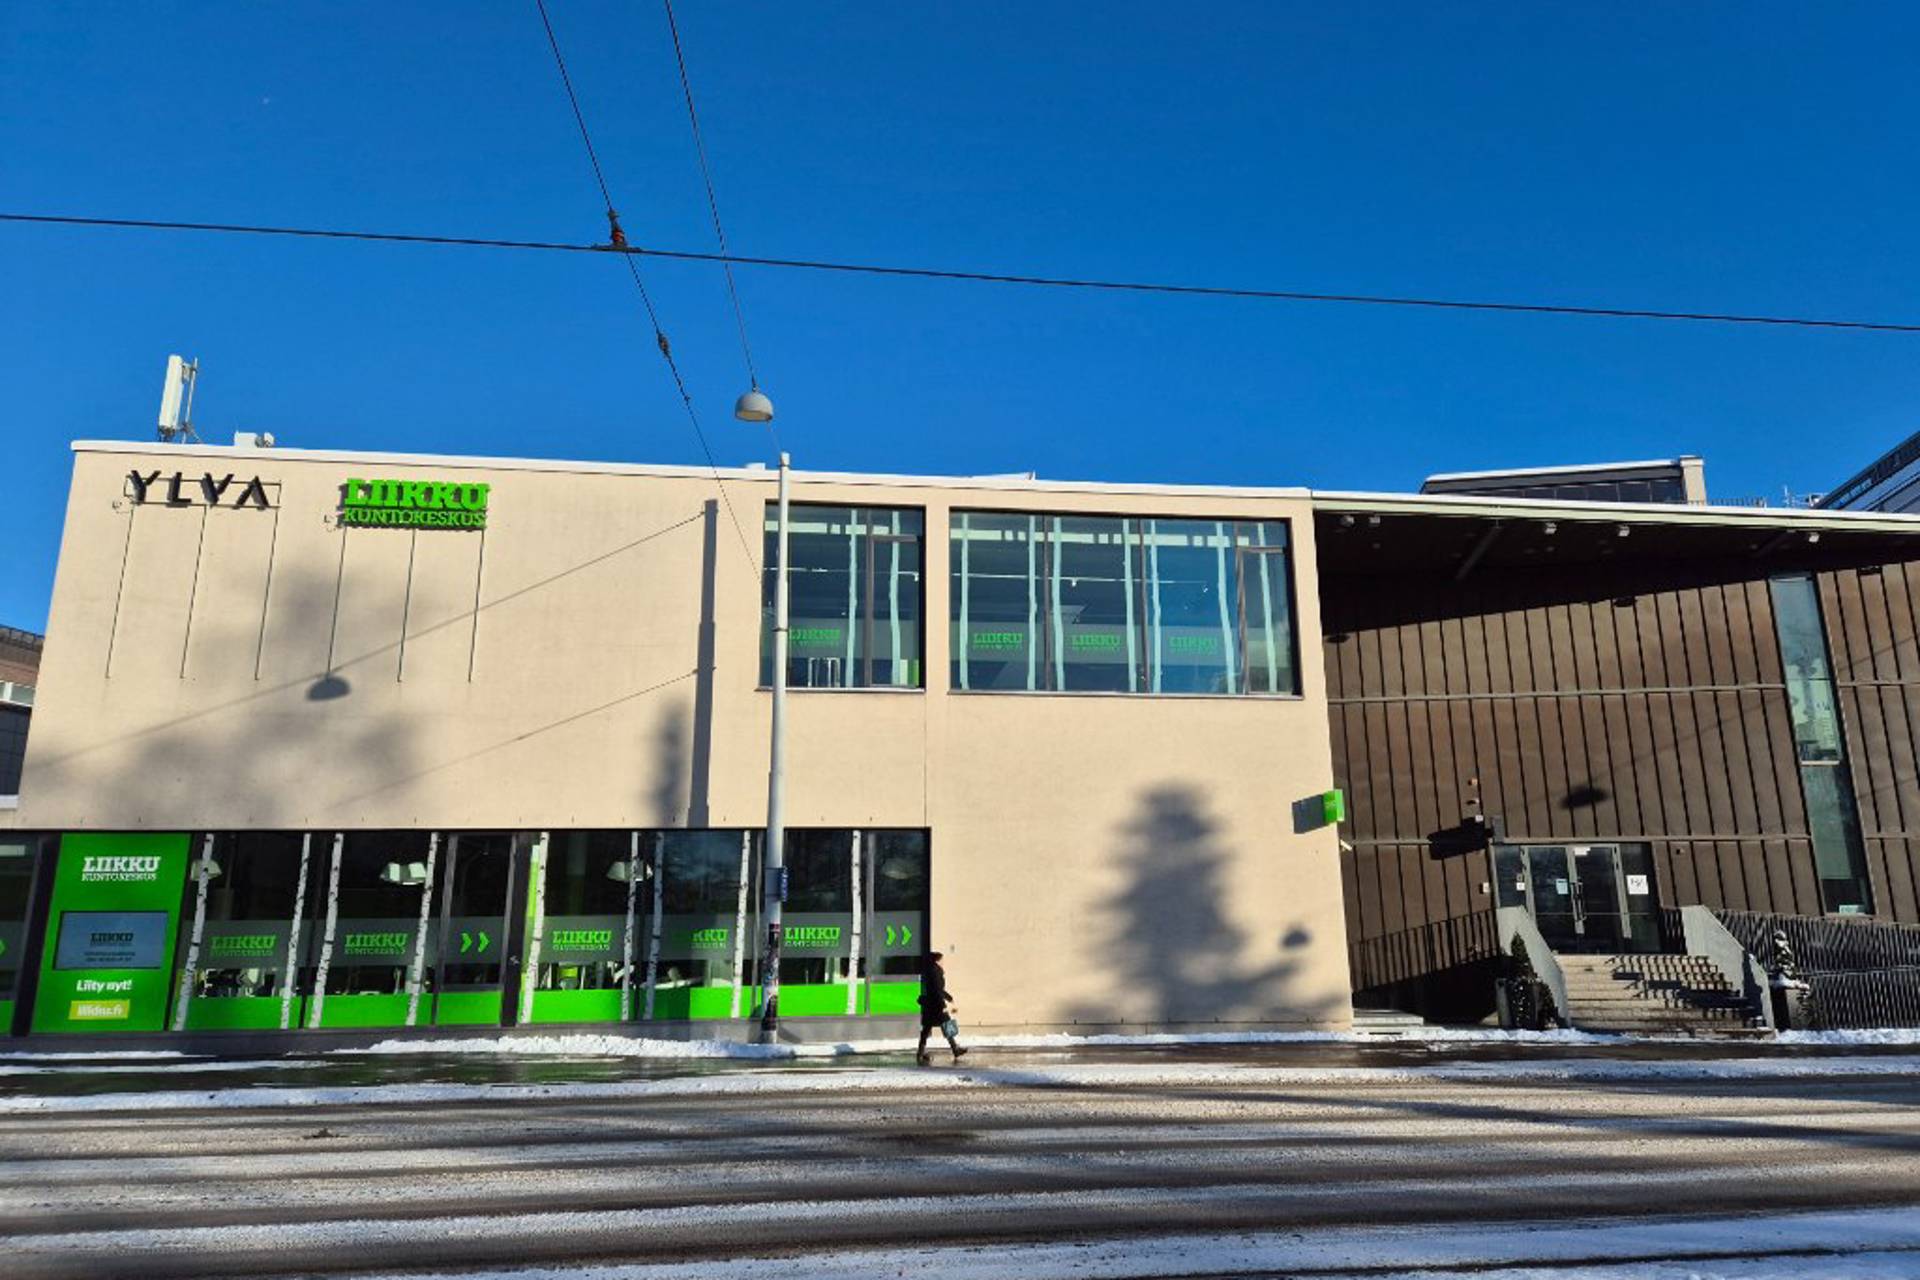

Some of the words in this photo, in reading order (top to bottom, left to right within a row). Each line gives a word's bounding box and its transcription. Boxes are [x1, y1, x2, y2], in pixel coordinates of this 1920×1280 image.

[128, 469, 271, 510] YLVA
[343, 478, 491, 511] LIIKKU
[343, 508, 488, 528] KUNTOKESKUS
[82, 856, 162, 872] LIIKKU
[344, 932, 409, 947] LIIKKU
[552, 930, 613, 944] LIIKKU
[784, 927, 841, 940] LIIKKU
[211, 935, 277, 949] LIIKKU
[76, 979, 105, 994] Liity
[106, 979, 133, 993] nyt!
